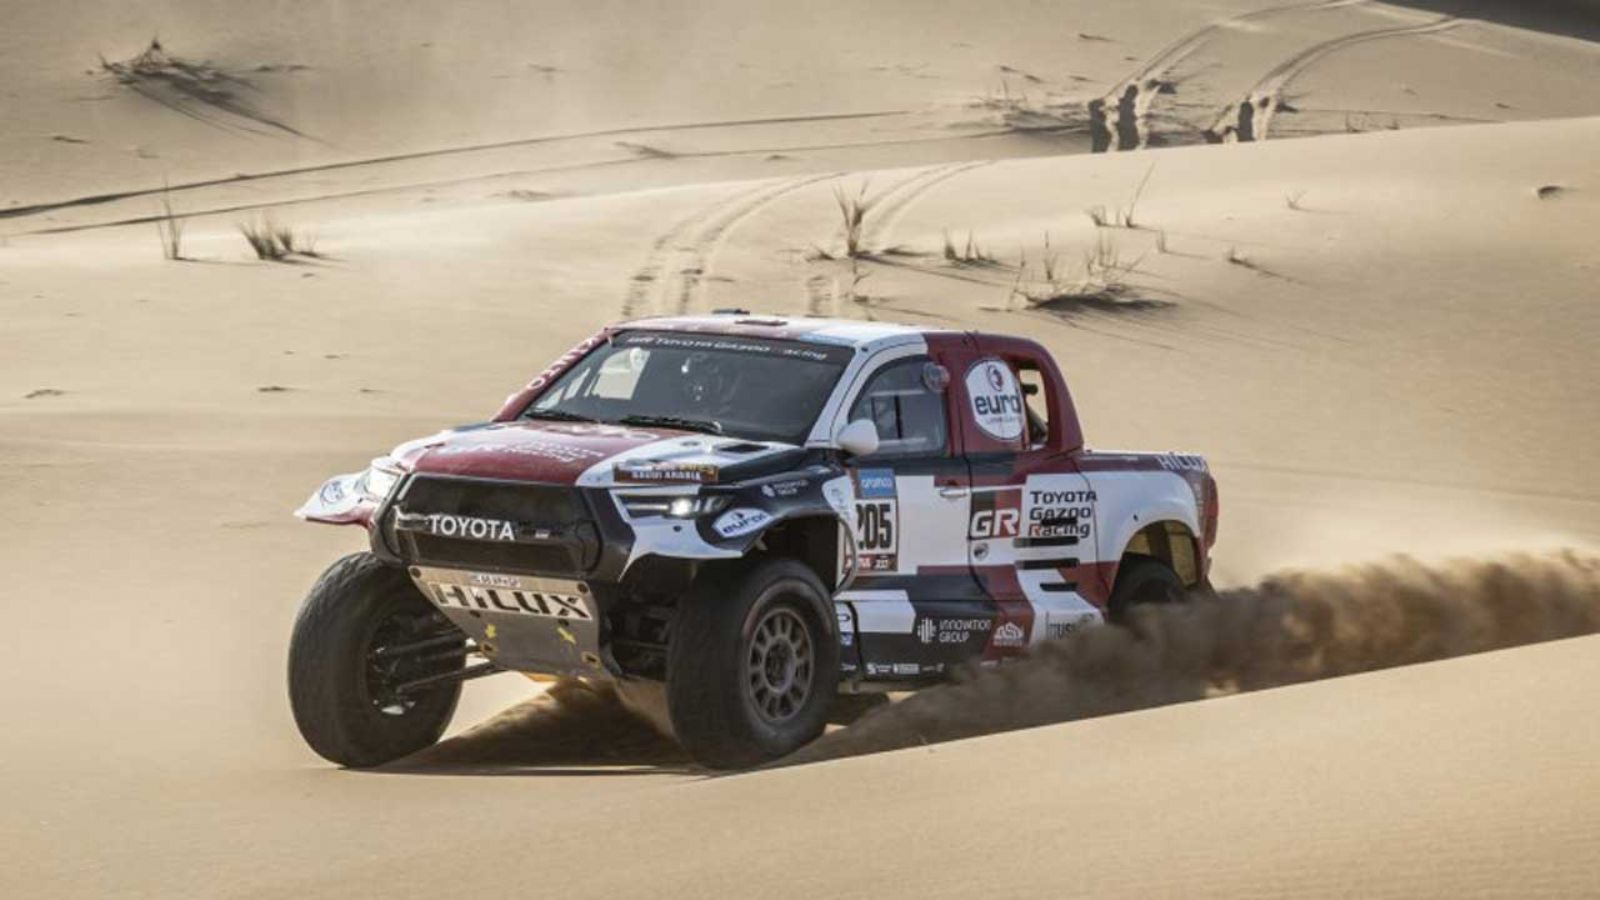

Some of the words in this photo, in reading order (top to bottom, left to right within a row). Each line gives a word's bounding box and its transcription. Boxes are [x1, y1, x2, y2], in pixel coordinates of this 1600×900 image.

[1029, 490, 1098, 505] TOYOTA
[429, 514, 516, 541] TOYOTA
[970, 508, 1019, 537] GR
[1027, 522, 1091, 539] Racing
[938, 630, 970, 643] GROUP
